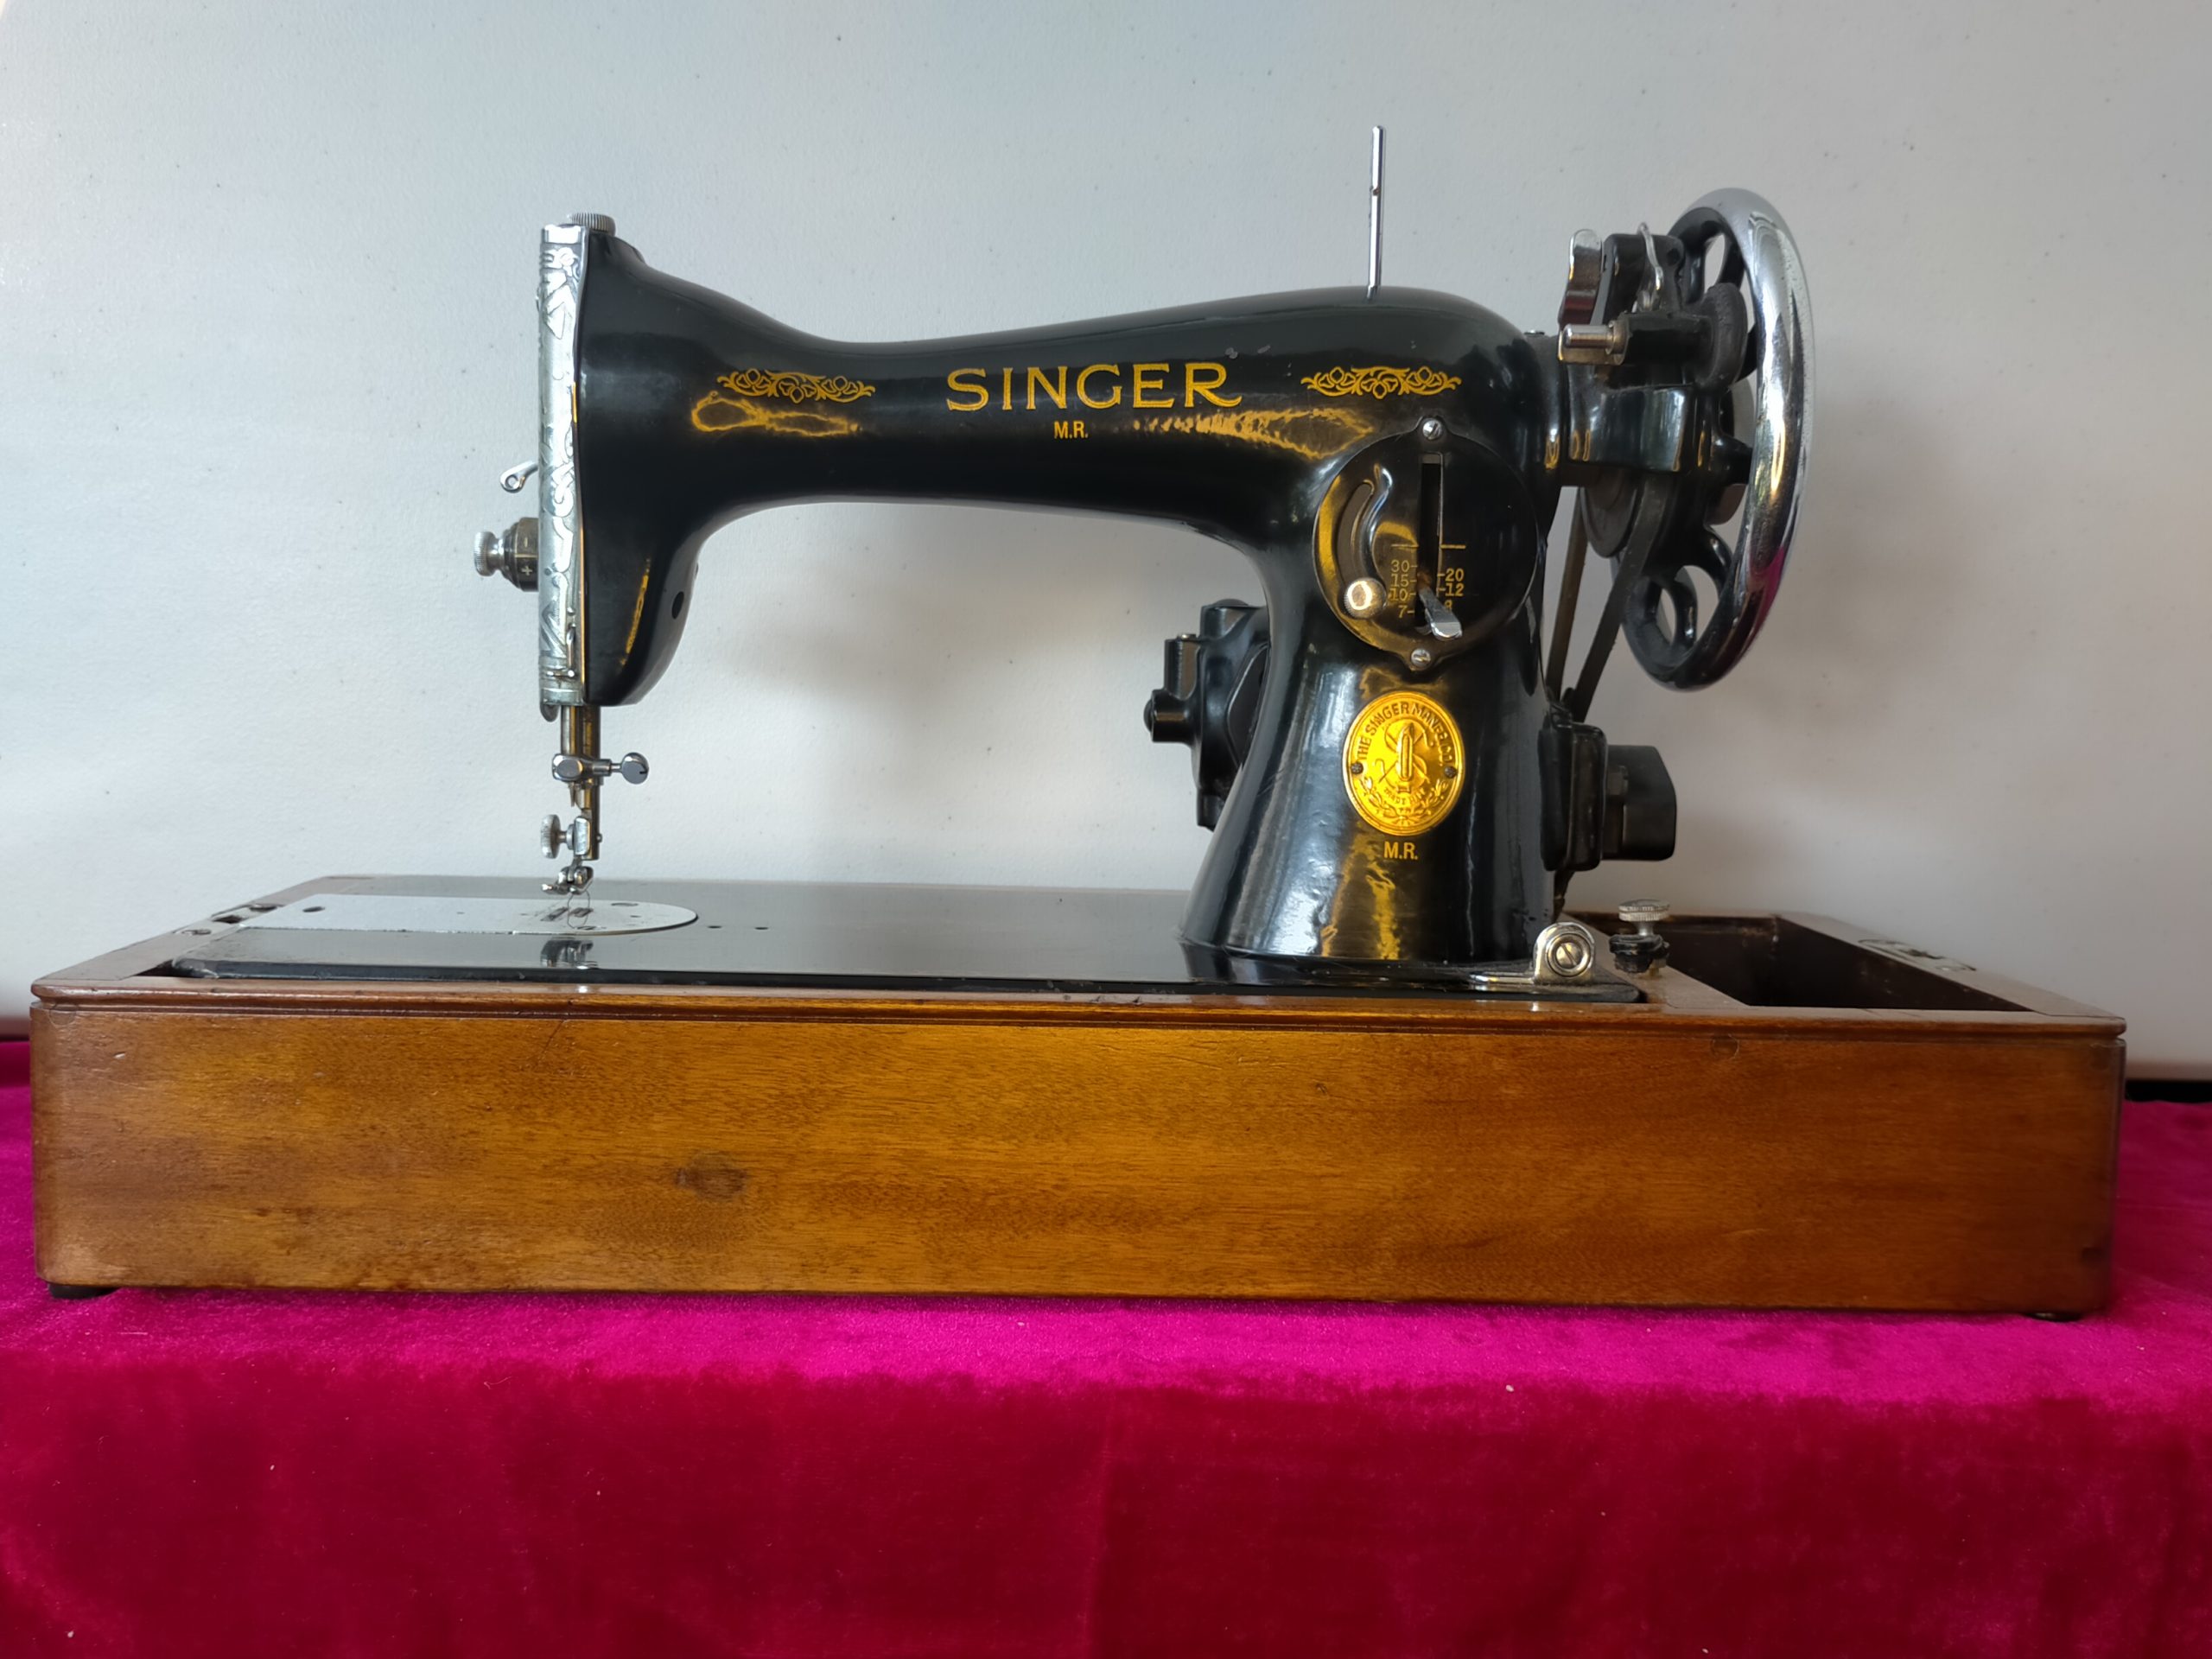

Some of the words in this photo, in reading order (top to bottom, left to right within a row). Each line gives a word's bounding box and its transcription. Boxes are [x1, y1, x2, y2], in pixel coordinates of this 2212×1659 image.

[946, 362, 1243, 411] SINGER
[1053, 420, 1089, 439] M.R.
[1390, 559, 1410, 573] 30
[1390, 573, 1409, 587] 15
[1445, 568, 1465, 582] 20
[1445, 582, 1465, 597] 12
[1398, 605, 1408, 619] 7
[1364, 701, 1410, 736] SINGER
[1357, 734, 1372, 760] THE
[1383, 841, 1419, 861] M.R.
